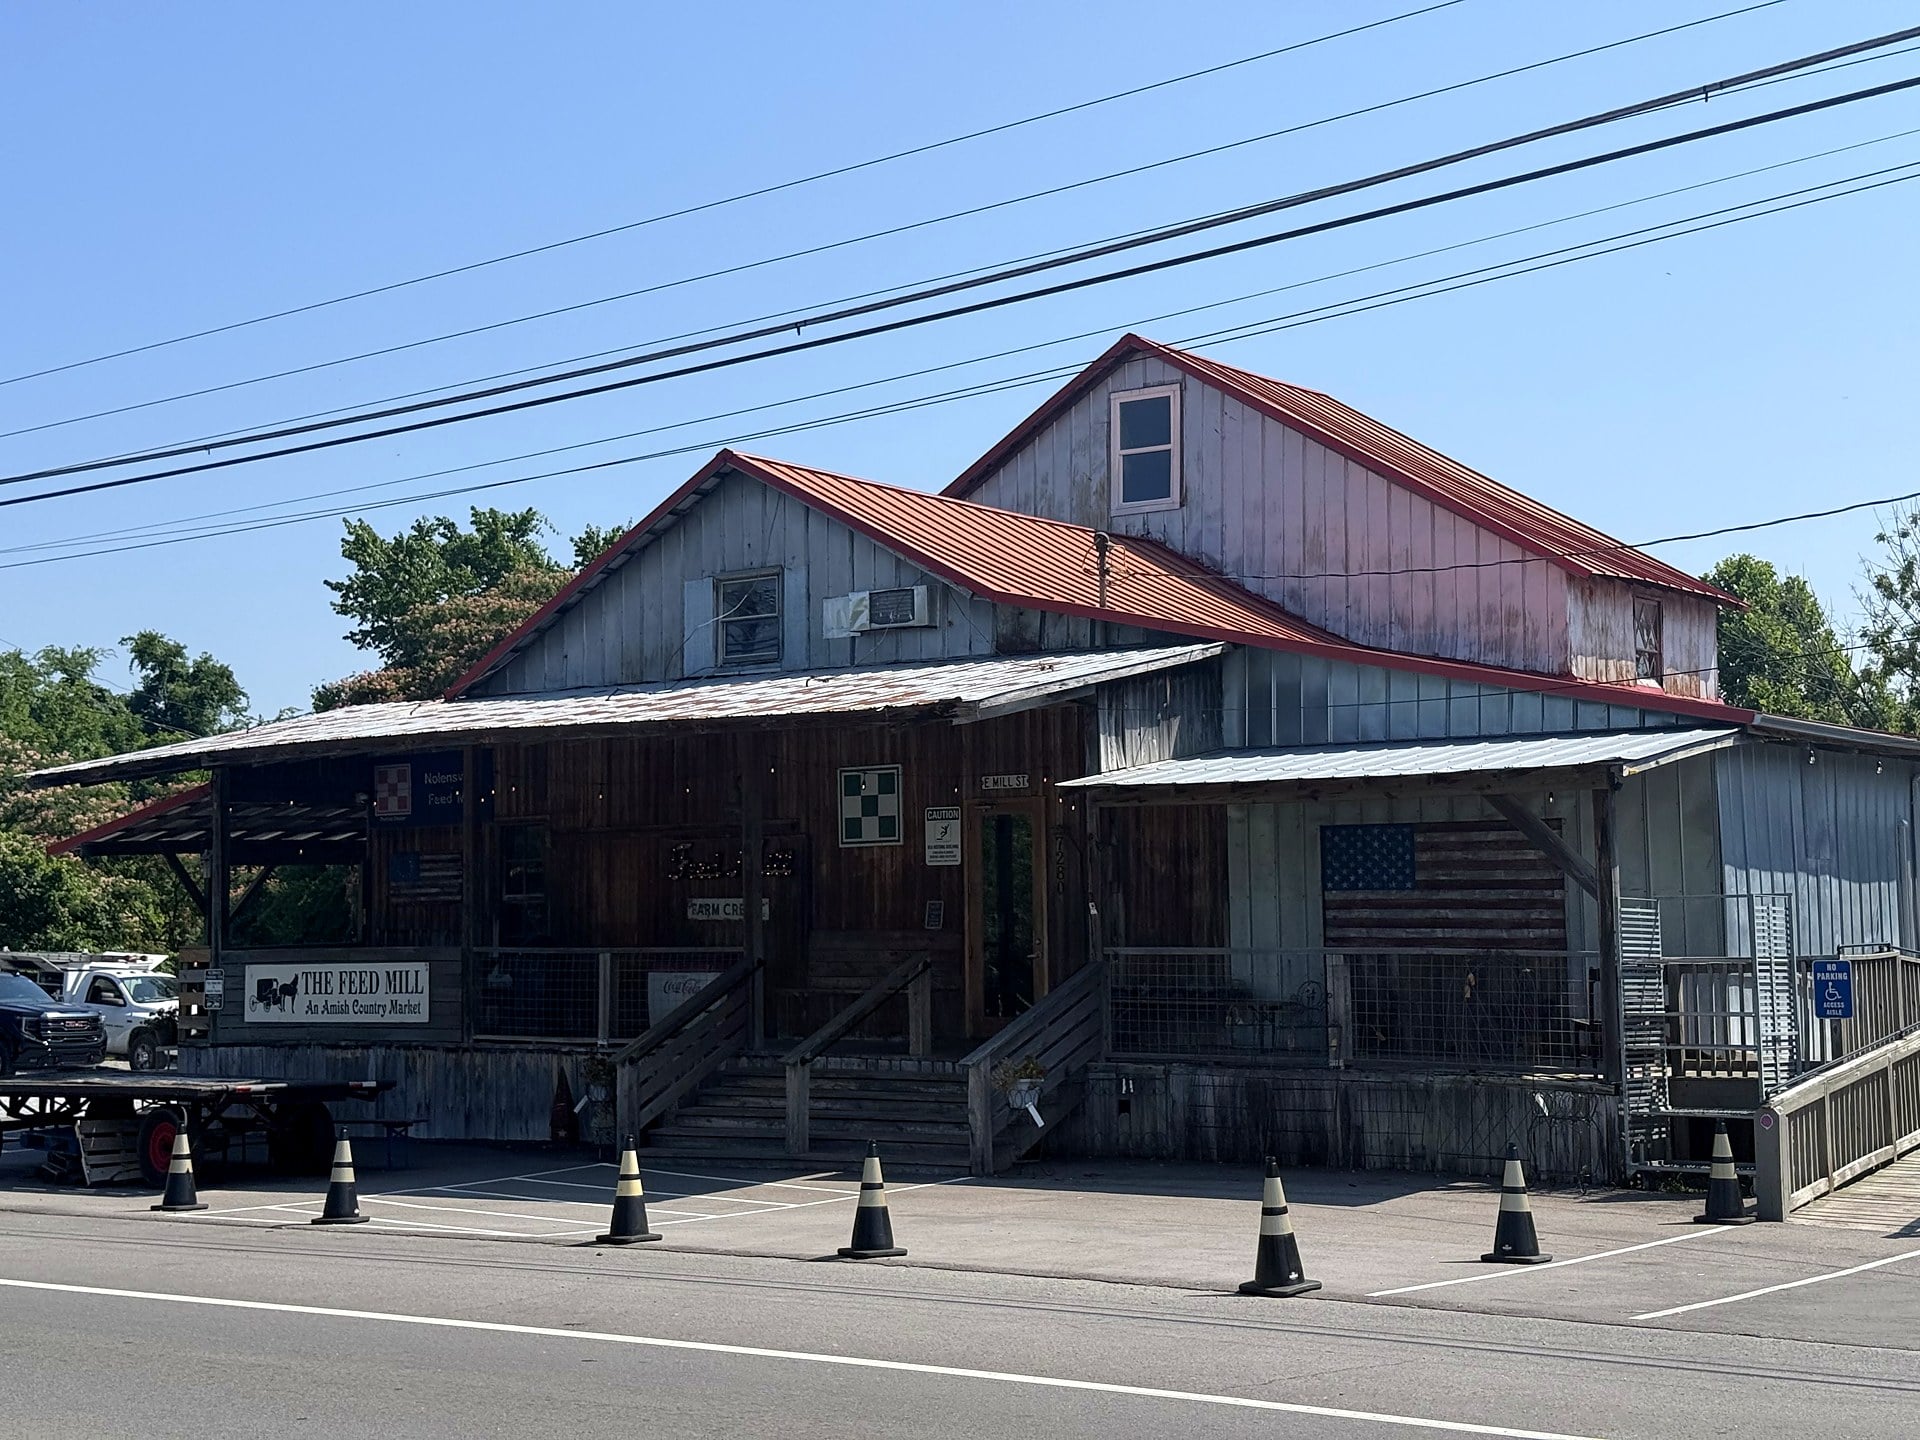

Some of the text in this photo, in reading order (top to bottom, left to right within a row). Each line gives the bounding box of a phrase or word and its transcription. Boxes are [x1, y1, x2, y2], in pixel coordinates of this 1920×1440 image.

[424, 772, 464, 784] Nolensv
[984, 775, 1026, 788] E MILL ST
[428, 792, 453, 805] Feed
[927, 810, 959, 819] CAUTION
[1056, 836, 1065, 894] 7280
[691, 903, 745, 916] FARM CRE
[1826, 963, 1837, 971] NO
[301, 970, 425, 995] THE FEED MILL
[1816, 972, 1848, 981] PARKING
[305, 999, 421, 1018] An Amish Country Market
